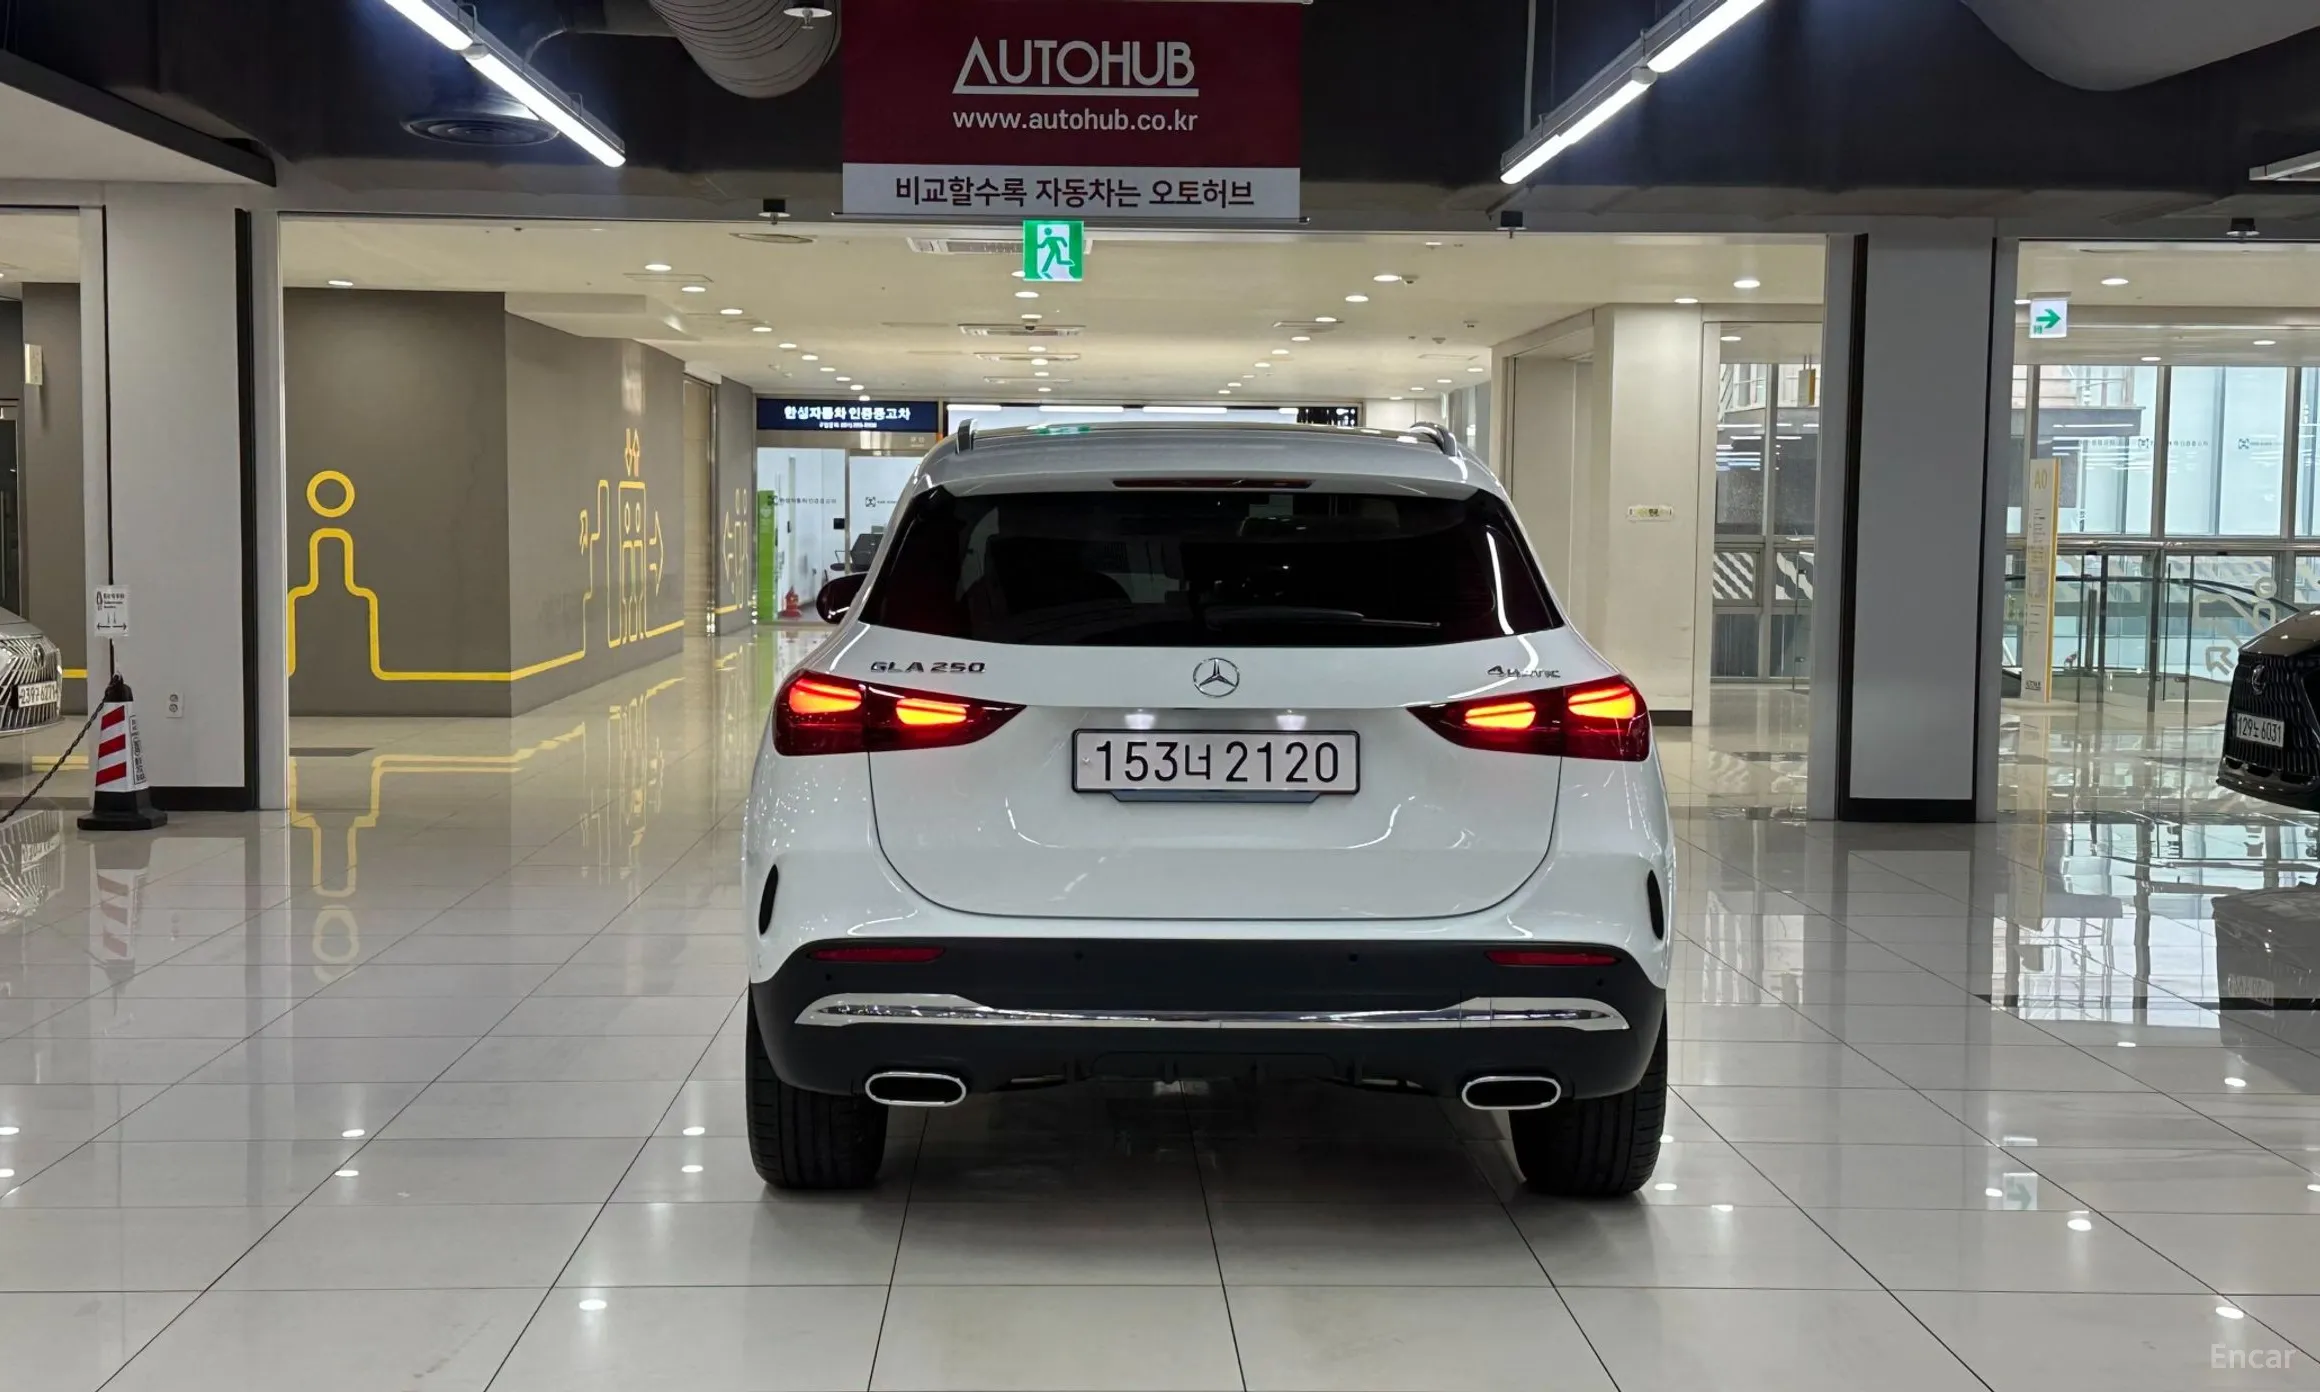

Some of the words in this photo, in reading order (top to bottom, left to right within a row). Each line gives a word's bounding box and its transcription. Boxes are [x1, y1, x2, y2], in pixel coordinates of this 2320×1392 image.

[952, 36, 1199, 96] AUTOHUB
[953, 108, 1199, 131] www.autohub.co.kr
[896, 176, 1027, 206] 비교할수록
[1035, 178, 1141, 208] 자동차는
[1148, 180, 1255, 209] 오토허브
[870, 661, 925, 673] GLA
[930, 661, 986, 673] 250
[1096, 740, 1211, 782] 153너
[1225, 741, 1339, 783] 2120
